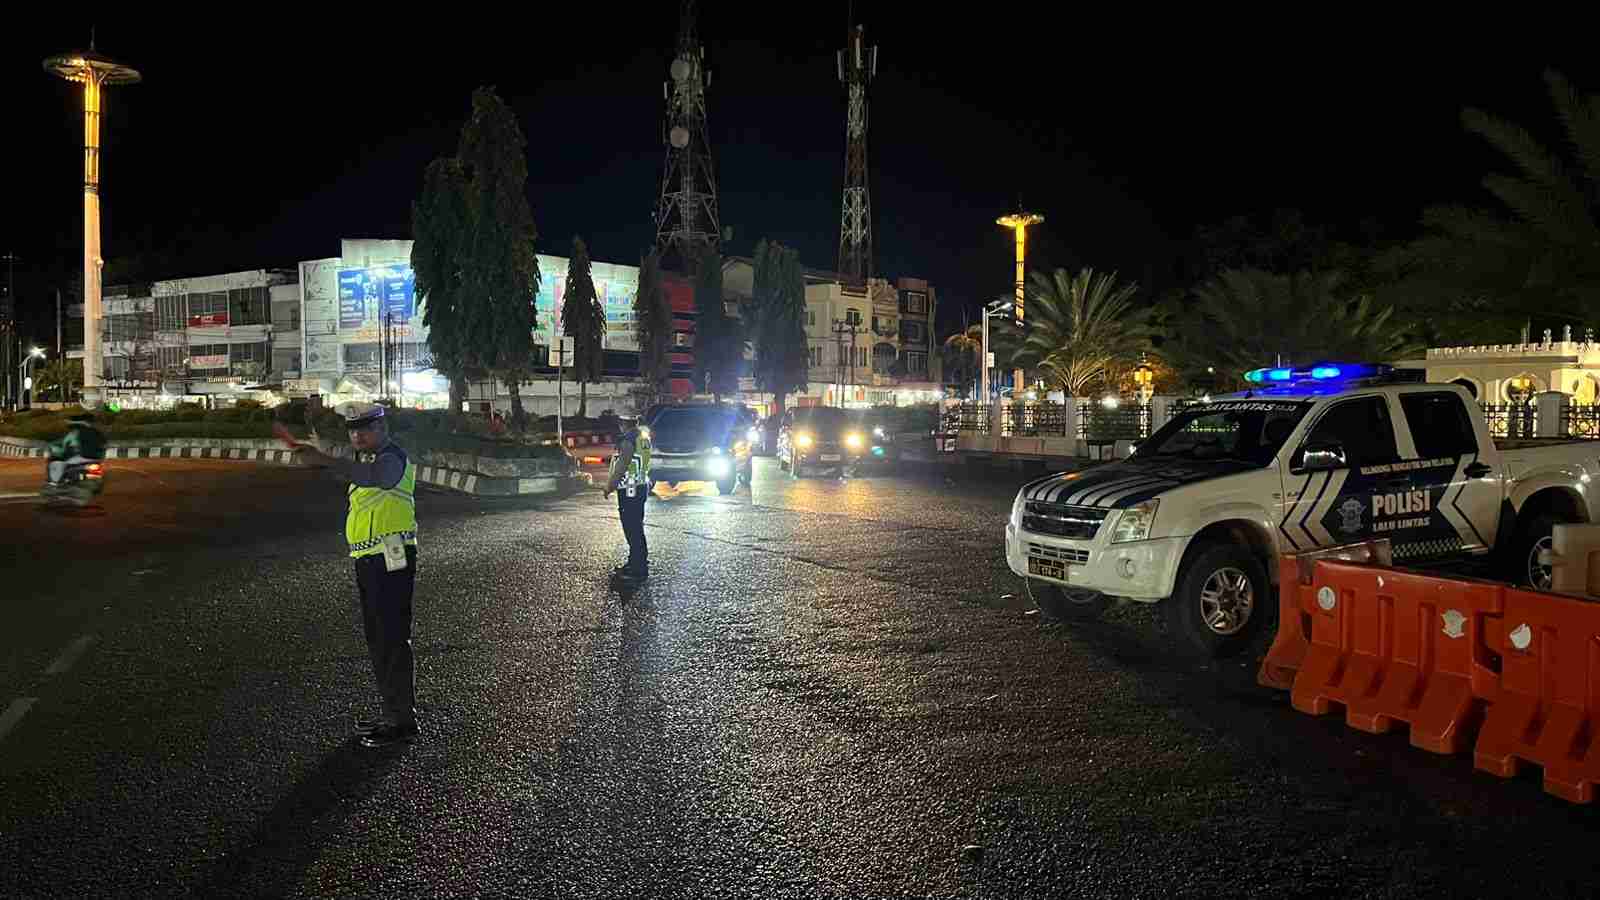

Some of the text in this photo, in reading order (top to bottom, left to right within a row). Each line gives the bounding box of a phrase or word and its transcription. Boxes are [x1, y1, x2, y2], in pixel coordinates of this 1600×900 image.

[1372, 490, 1430, 516] POLISI
[1373, 517, 1430, 532] LALU LINTAS
